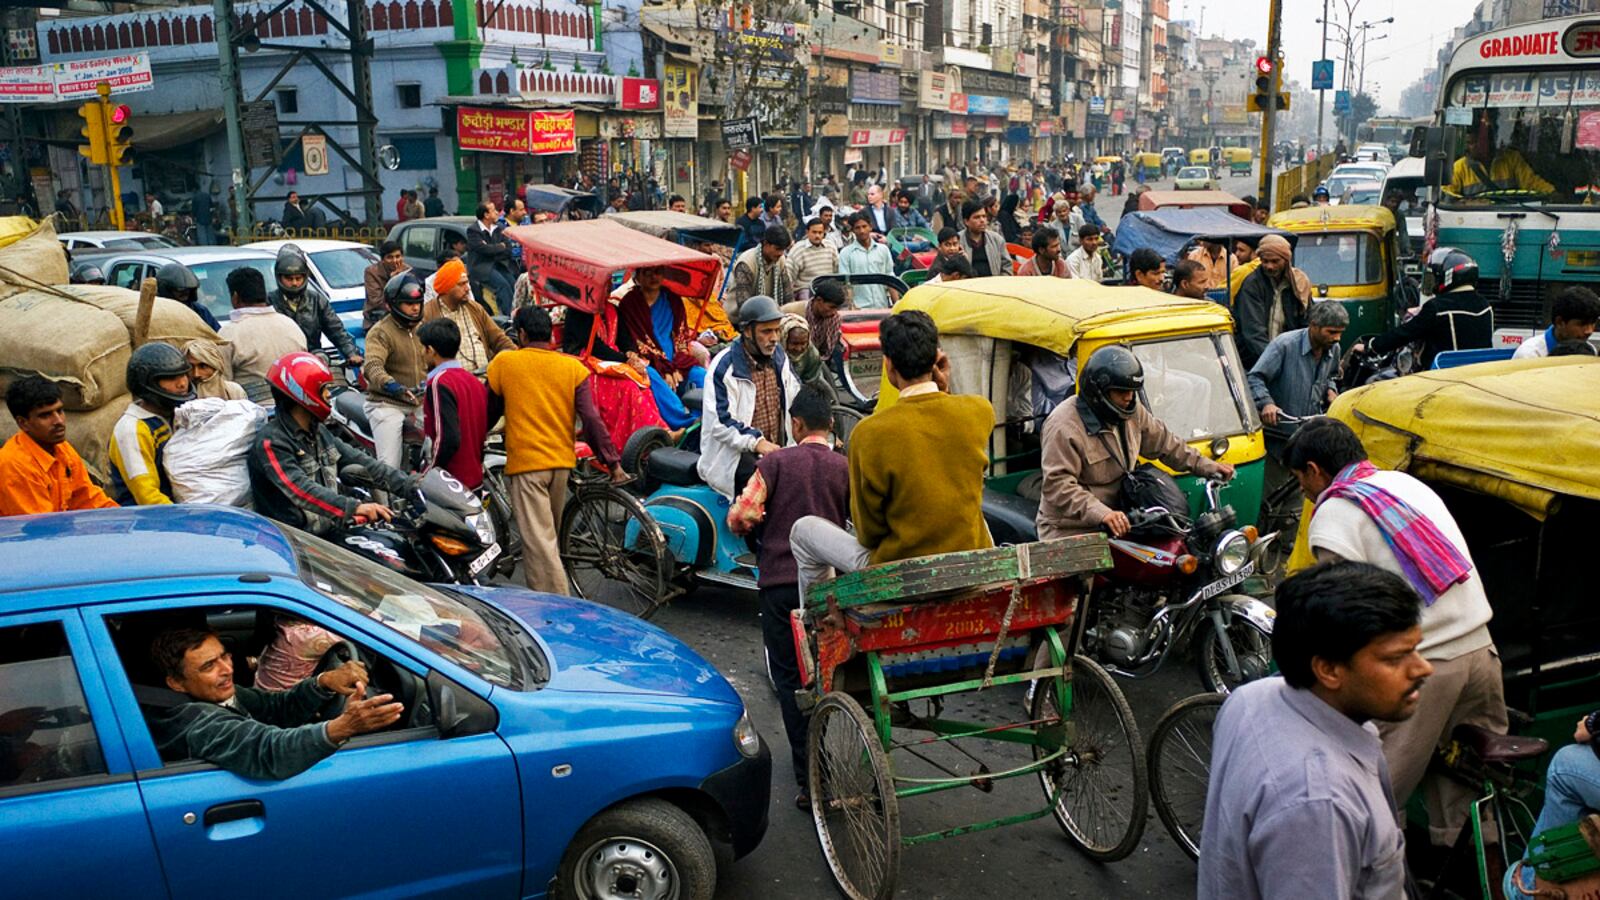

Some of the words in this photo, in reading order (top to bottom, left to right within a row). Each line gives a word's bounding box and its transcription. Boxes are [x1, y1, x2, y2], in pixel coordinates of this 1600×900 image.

[1480, 31, 1558, 58] GRADUATE
[70, 61, 88, 70] Road
[90, 59, 112, 68] Safety
[113, 55, 132, 64] Week
[61, 83, 80, 92] DRIVE
[80, 82, 89, 90] TO
[123, 76, 131, 84] TO
[131, 74, 148, 83] DARE
[495, 136, 502, 147] 7
[521, 137, 529, 149] 4
[585, 284, 595, 304] K
